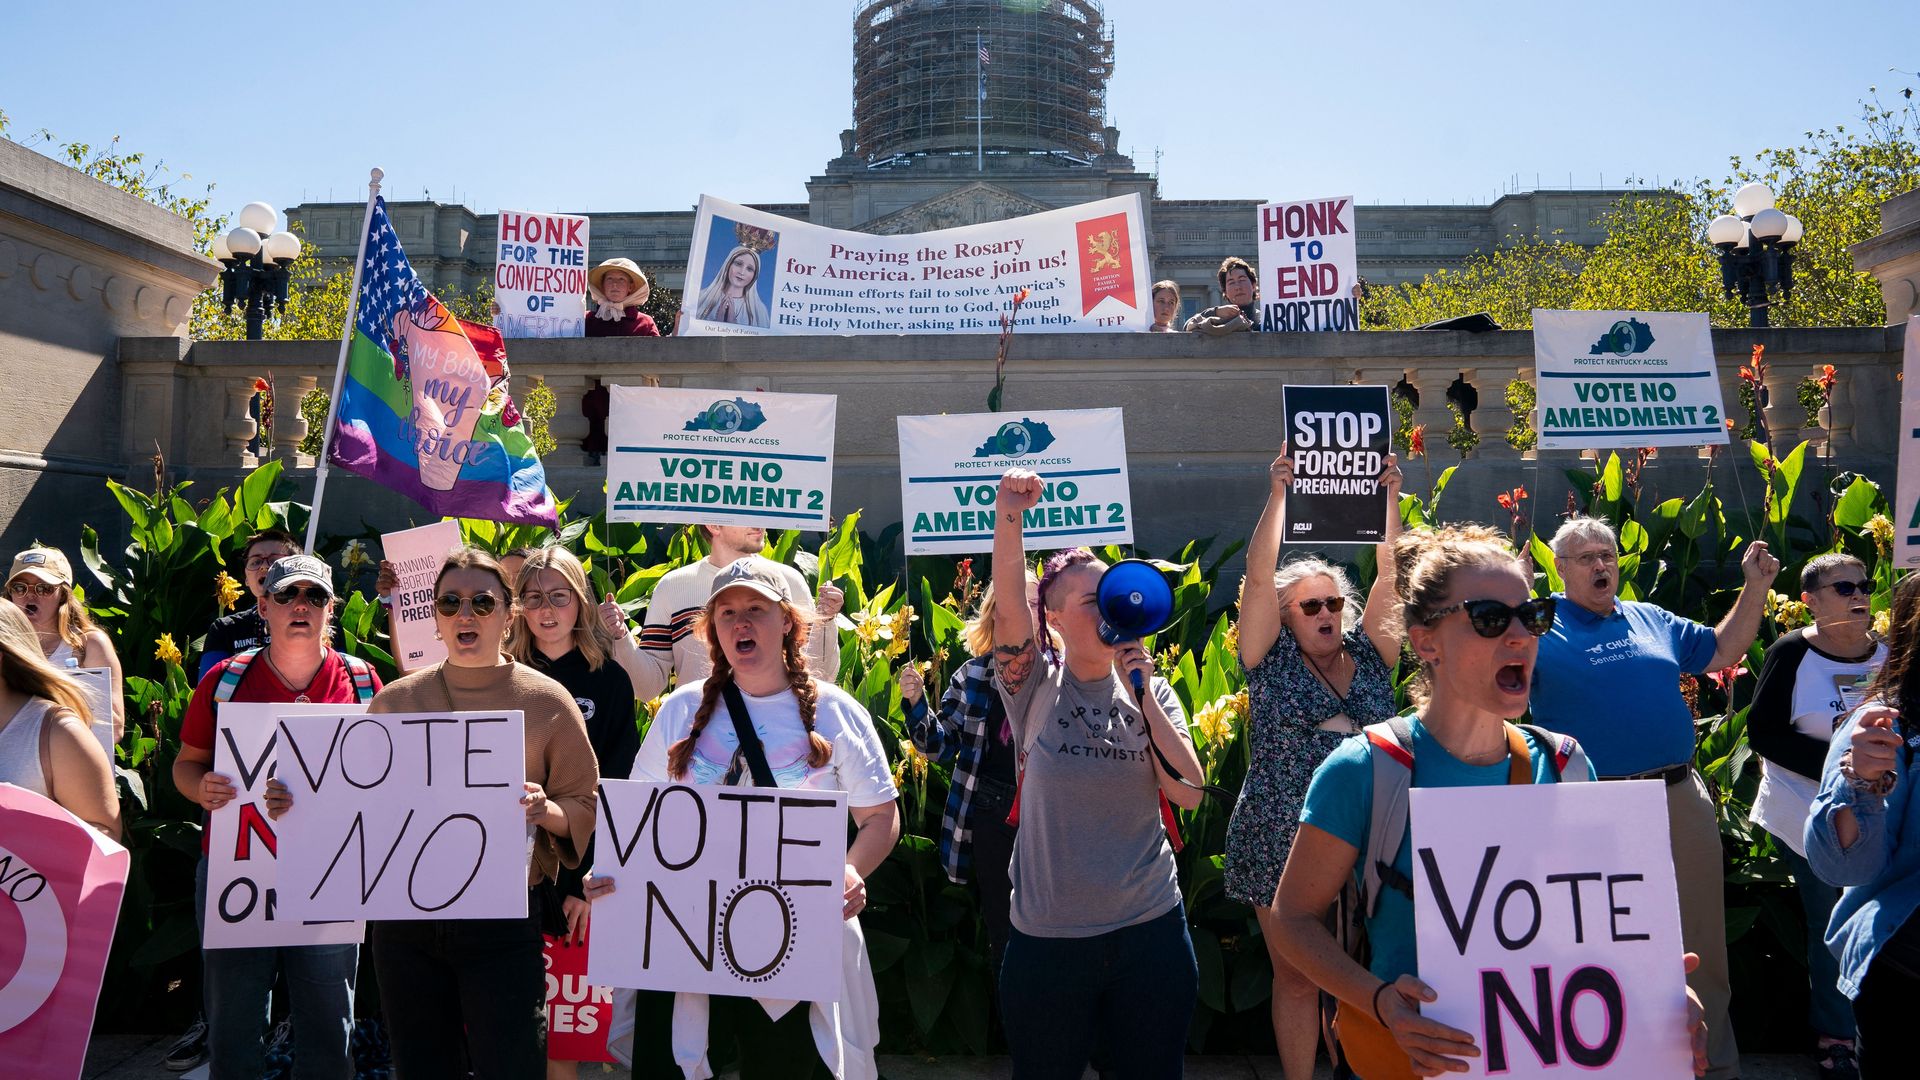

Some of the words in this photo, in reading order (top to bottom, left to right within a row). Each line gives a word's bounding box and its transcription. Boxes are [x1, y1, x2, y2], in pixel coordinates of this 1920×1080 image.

[502, 214, 584, 247] HONK
[1263, 199, 1349, 241] HONK
[501, 244, 537, 263] FOR
[548, 248, 584, 266] THE
[830, 244, 909, 266] Praying
[916, 247, 947, 261] the
[954, 239, 1024, 259] Rosary
[1290, 240, 1323, 262] TO
[786, 257, 817, 276] for
[822, 264, 915, 281] America.
[922, 265, 985, 280] Please
[990, 258, 1030, 280] join
[1038, 250, 1067, 271] us!
[497, 264, 587, 295] CONVERSION
[781, 282, 800, 293] As
[804, 284, 854, 297] human
[858, 288, 904, 299] efforts
[909, 288, 931, 299] fail
[937, 288, 950, 298] to
[954, 286, 990, 298] solve
[1277, 263, 1338, 299] END
[527, 295, 554, 312] OF
[780, 298, 805, 312] key
[810, 301, 880, 314] problems,
[885, 305, 904, 314] we
[909, 304, 939, 314] turn
[948, 304, 959, 314] to
[963, 301, 999, 313] God,
[1262, 298, 1359, 332] ABORTION
[497, 313, 583, 338] AMERICA
[778, 314, 803, 326] His
[807, 316, 842, 331] Holy
[846, 319, 904, 331] Mother,
[908, 318, 955, 331] asking
[960, 318, 984, 328] His
[1041, 313, 1077, 327] help.
[1096, 315, 1125, 327] TFP
[413, 342, 439, 369] MY
[1574, 358, 1604, 366] PROTECT
[1606, 358, 1642, 366] KENTUCKY
[1643, 358, 1668, 366] ACCESS
[424, 378, 474, 428] my
[1573, 382, 1637, 403] VOTE
[1641, 382, 1676, 403] NO
[1294, 411, 1382, 448] STOP
[1543, 406, 1698, 428] AMENDMENT
[1701, 405, 1720, 425] 2
[398, 406, 490, 467] choice
[663, 433, 700, 442] PROTECT
[702, 435, 746, 444] KENTUCKY
[748, 437, 780, 446] ACCESS
[659, 457, 733, 480] VOTE
[740, 461, 783, 483] NO
[954, 460, 991, 469] PROTECT
[993, 458, 1037, 467] KENTUCKY
[1040, 457, 1072, 465] ACCESS
[1293, 450, 1381, 476] FORCED
[614, 481, 802, 509] AMENDMENT
[807, 489, 824, 510] 2
[953, 485, 1000, 506] VO
[1293, 478, 1379, 496] PREGNANCY
[912, 504, 1101, 533] AMENMENT
[1106, 502, 1125, 524] 2
[1293, 522, 1313, 531] ACLU
[393, 554, 436, 576] BANNING
[399, 593, 411, 607] IS
[412, 588, 434, 604] FOR
[408, 650, 424, 659] ACLU
[1589, 653, 1625, 666] Senate
[1058, 706, 1146, 737] SUPPORT
[279, 718, 510, 793] VOTE
[1058, 743, 1145, 762] ACTIVISTS
[597, 783, 837, 887] VOTE
[309, 809, 487, 912] NO
[1418, 845, 1650, 956] VOTE
[642, 879, 792, 978] NO
[1478, 963, 1627, 1076] NO
